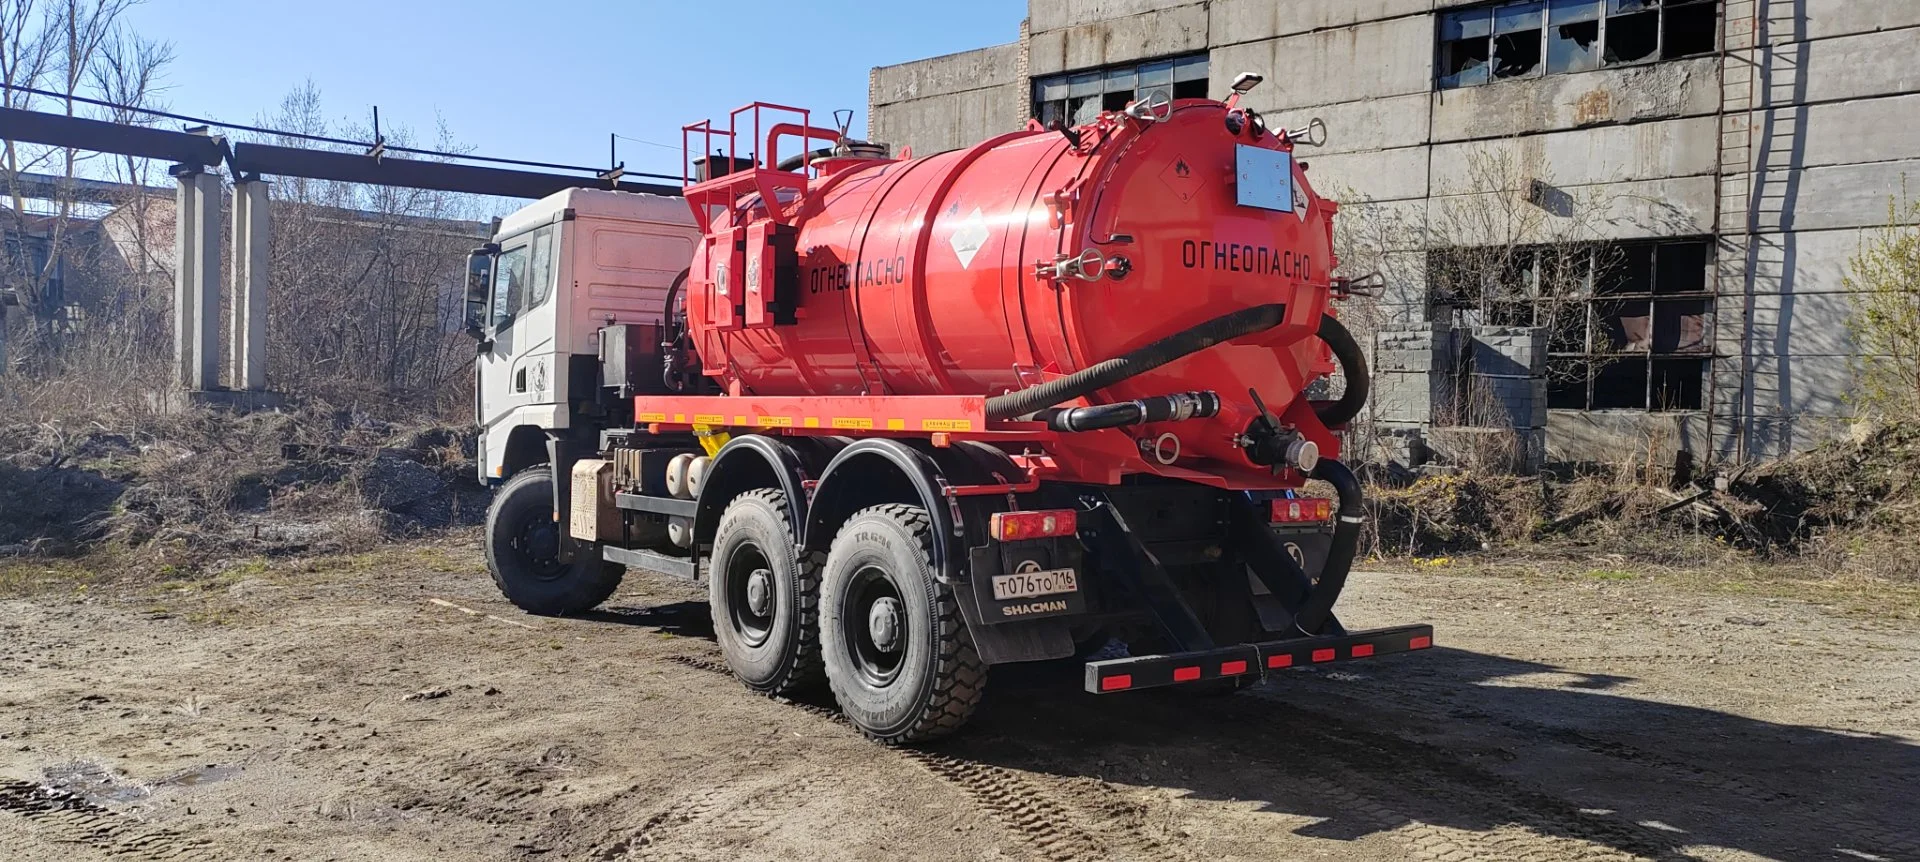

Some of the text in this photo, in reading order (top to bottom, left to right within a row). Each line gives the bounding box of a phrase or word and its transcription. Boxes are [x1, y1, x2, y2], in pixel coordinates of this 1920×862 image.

[1183, 240, 1310, 280] ОГНЕОПАСНО
[811, 256, 904, 294] ОГНЕОПАСНО
[1053, 572, 1073, 585] 716
[1002, 600, 1067, 616] SHACMAN
